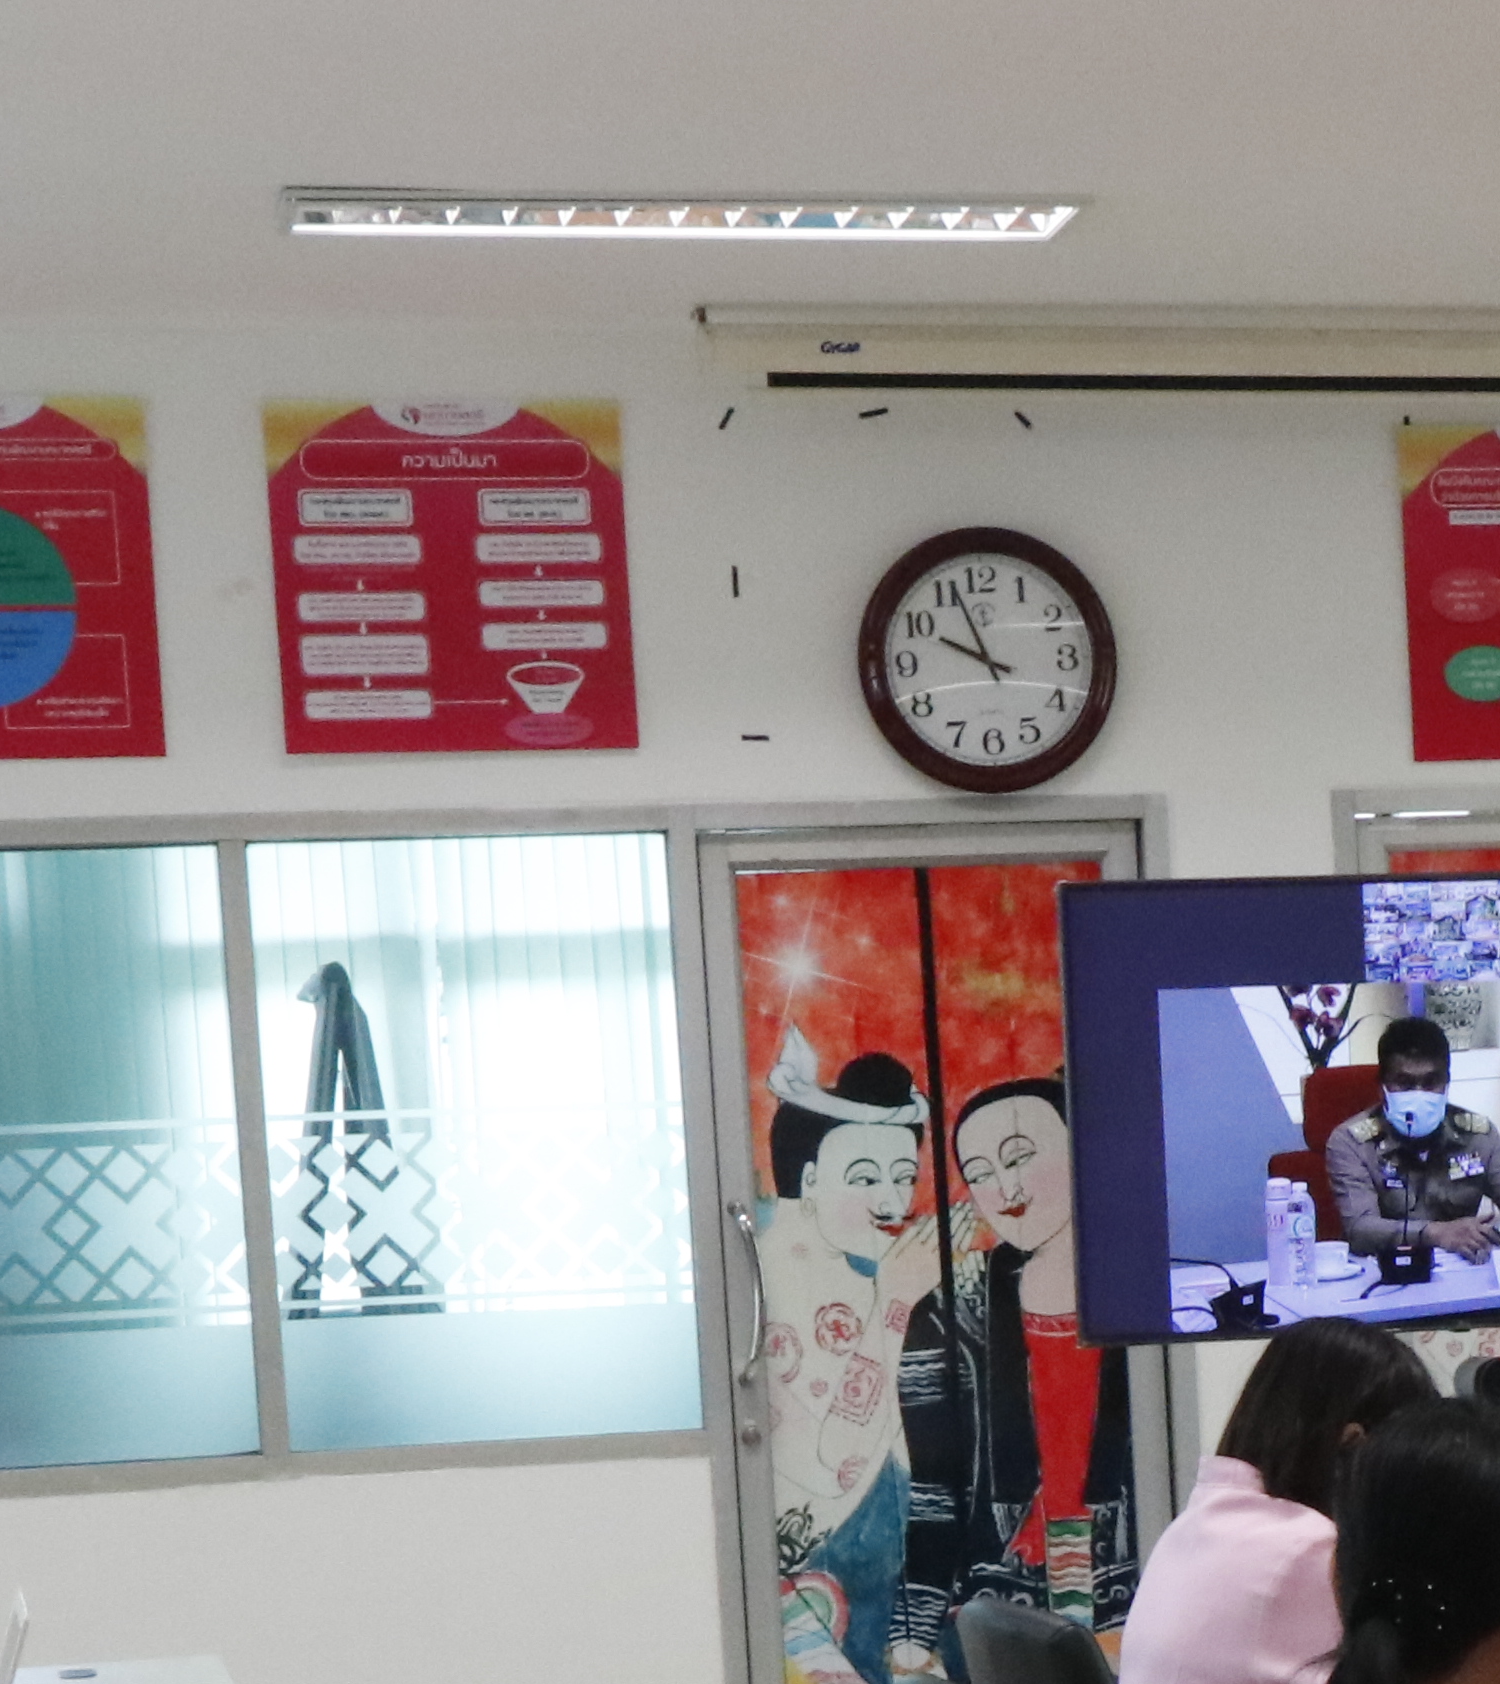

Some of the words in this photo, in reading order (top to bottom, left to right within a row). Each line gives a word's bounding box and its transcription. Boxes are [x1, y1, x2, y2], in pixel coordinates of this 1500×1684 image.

[401, 447, 497, 469] ความเป็นมา
[933, 579, 960, 607] 11
[963, 565, 996, 594] 12
[1014, 576, 1025, 603] 1
[905, 610, 934, 638] 10
[1044, 604, 1062, 632] 2
[895, 650, 918, 678] 9
[1057, 644, 1079, 671] 3
[911, 692, 933, 717] 8
[1045, 688, 1066, 712] 4
[946, 720, 968, 748] 7
[982, 728, 1005, 756] 6
[1019, 717, 1041, 744] 5
